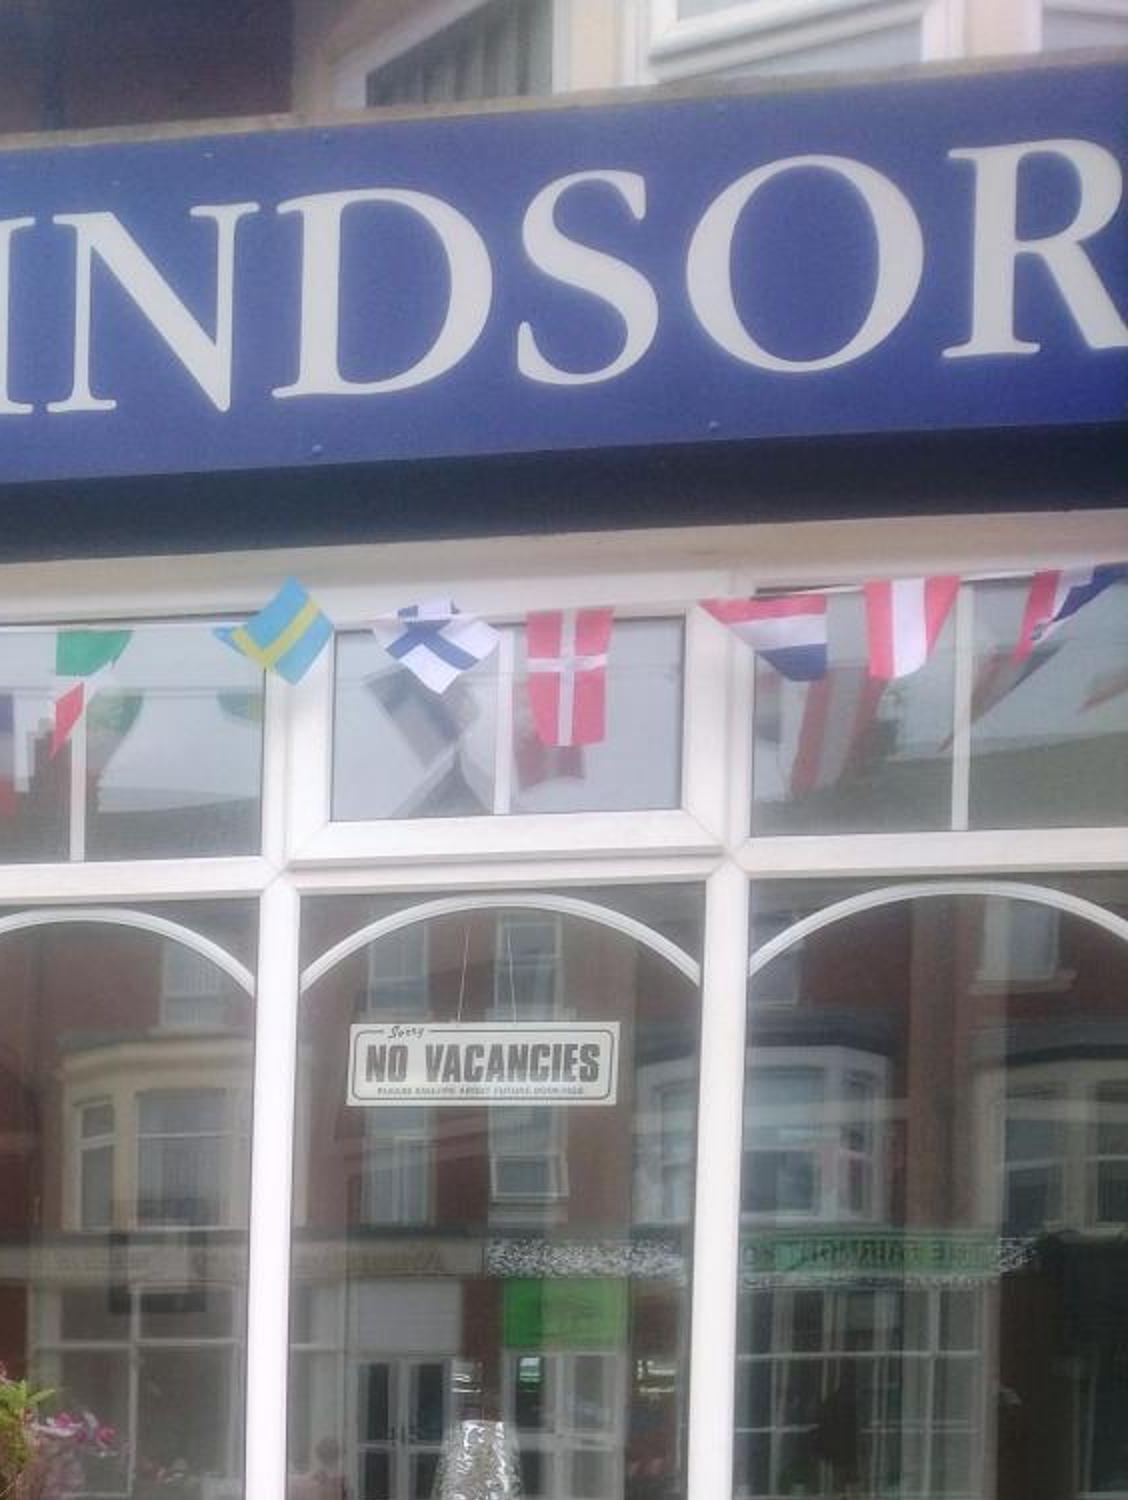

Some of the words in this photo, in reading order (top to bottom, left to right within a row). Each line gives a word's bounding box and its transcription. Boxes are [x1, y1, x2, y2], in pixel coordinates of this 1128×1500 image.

[387, 1025, 425, 1039] Sorry
[364, 1044, 409, 1084] NO
[424, 1043, 602, 1084] VACANCIES
